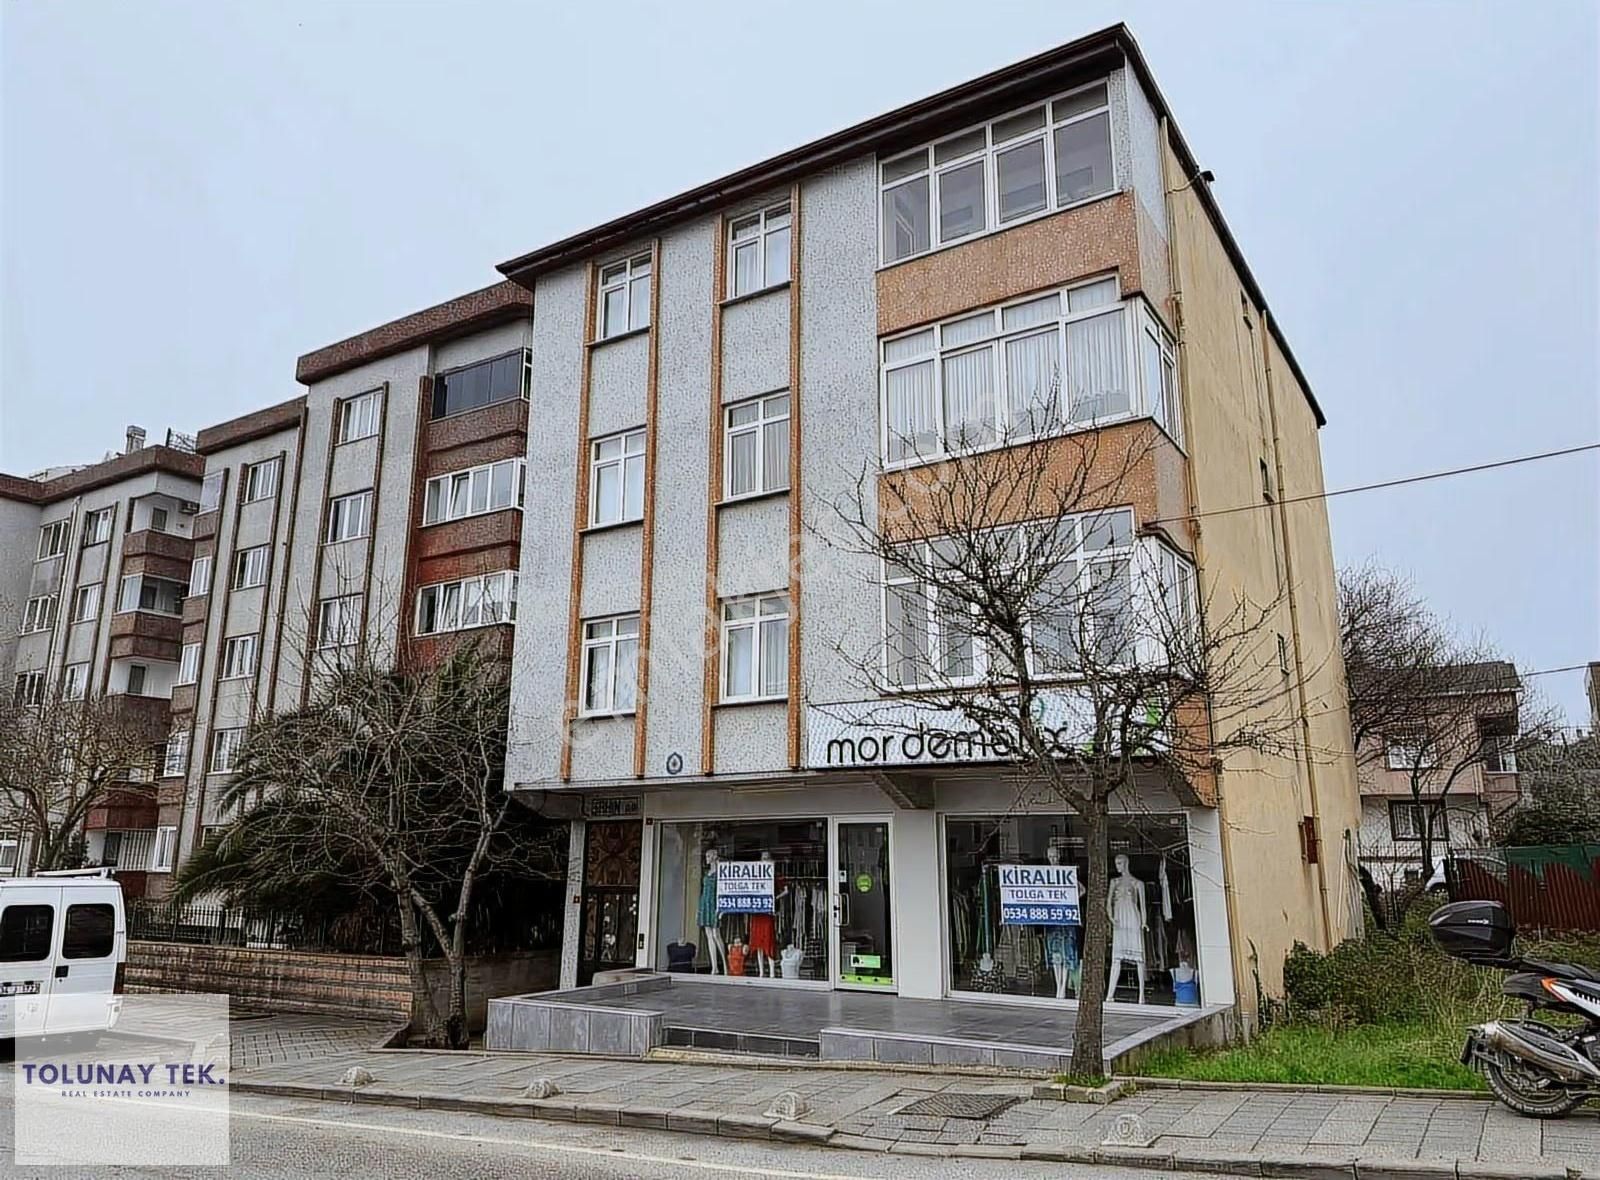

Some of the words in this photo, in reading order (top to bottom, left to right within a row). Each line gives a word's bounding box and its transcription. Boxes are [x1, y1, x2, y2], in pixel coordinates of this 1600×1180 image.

[827, 735, 894, 763] mor
[719, 861, 772, 878] KİRALIK
[1002, 866, 1074, 885] KİRALIK
[724, 882, 749, 891] TOLGA
[752, 882, 766, 890] TEK
[1009, 889, 1044, 899] TOLGA
[1047, 889, 1067, 900] TEK
[1003, 908, 1028, 920] 0534
[1029, 908, 1049, 920] 888
[1050, 909, 1063, 920] 59
[1065, 909, 1079, 921] 92
